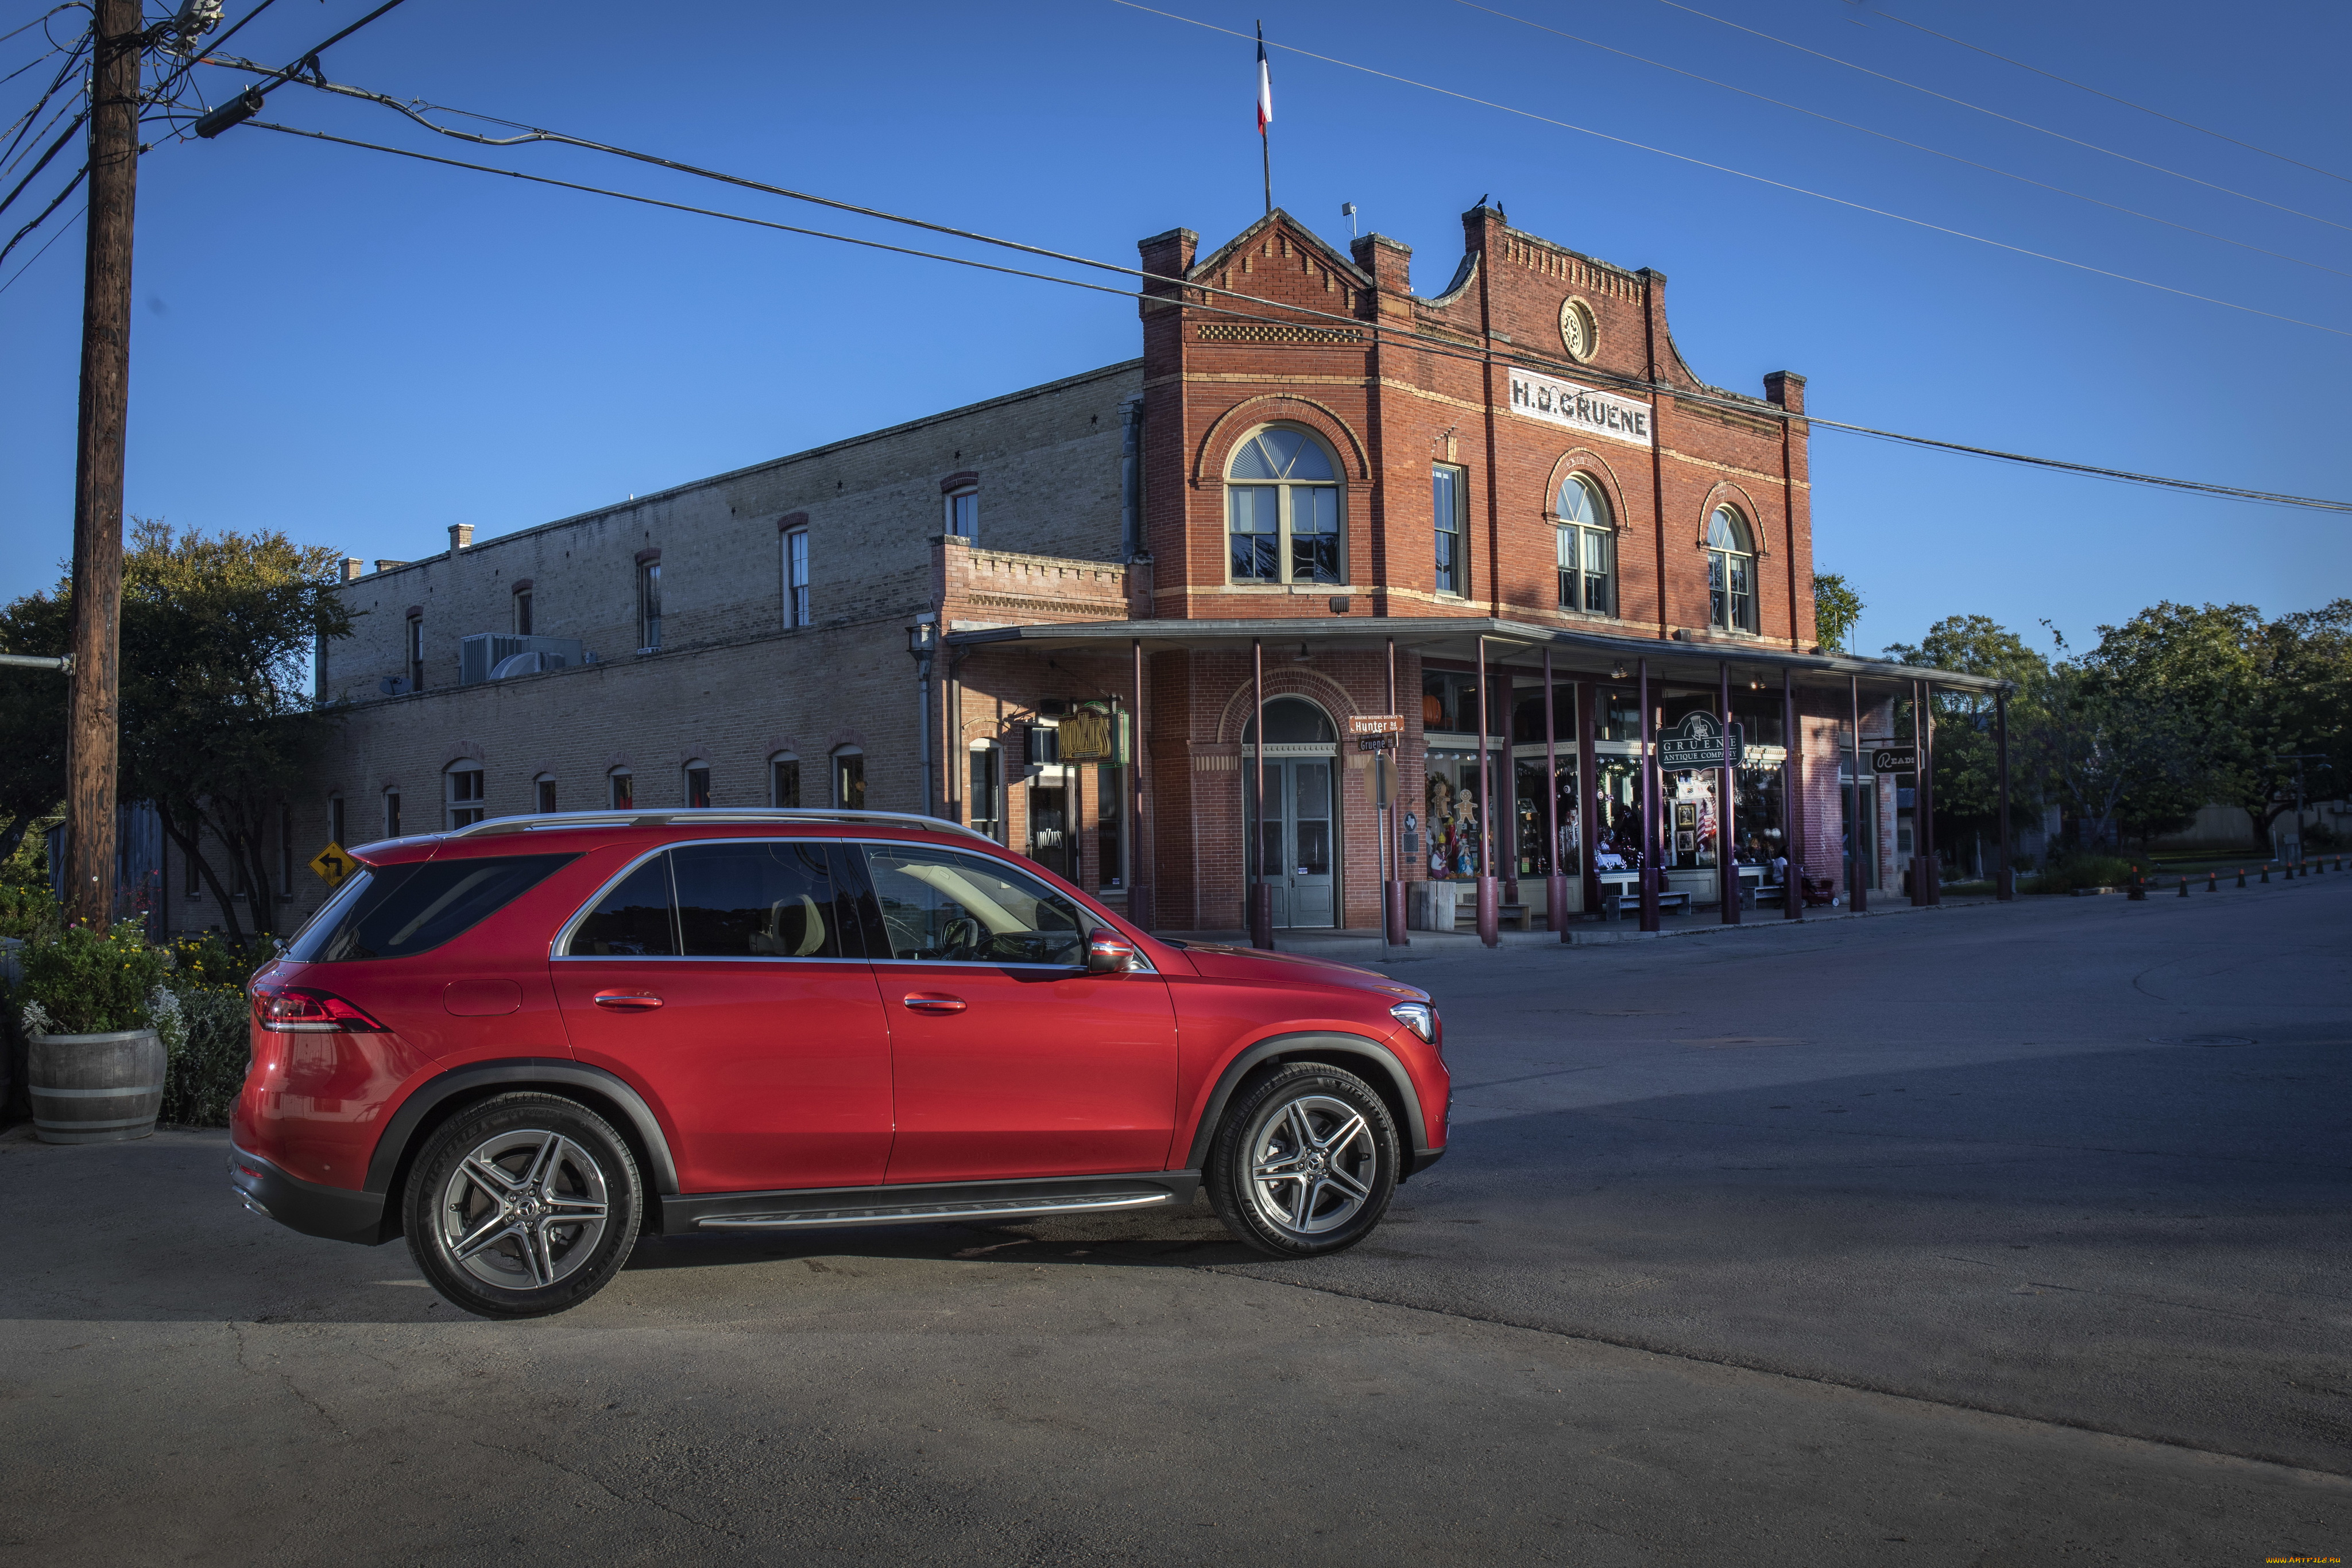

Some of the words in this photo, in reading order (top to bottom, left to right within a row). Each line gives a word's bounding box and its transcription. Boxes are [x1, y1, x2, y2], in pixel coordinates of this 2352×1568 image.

[1356, 721, 1387, 731] Hunter
[1361, 740, 1385, 750] Gruene
[1664, 738, 1736, 751] GRUENE
[1664, 753, 1698, 761] ANTIQUE
[1339, 1083, 1387, 1128] MICHELIN
[425, 1125, 478, 1194] MICHELIN
[1245, 1203, 1295, 1248] MICHELIN
